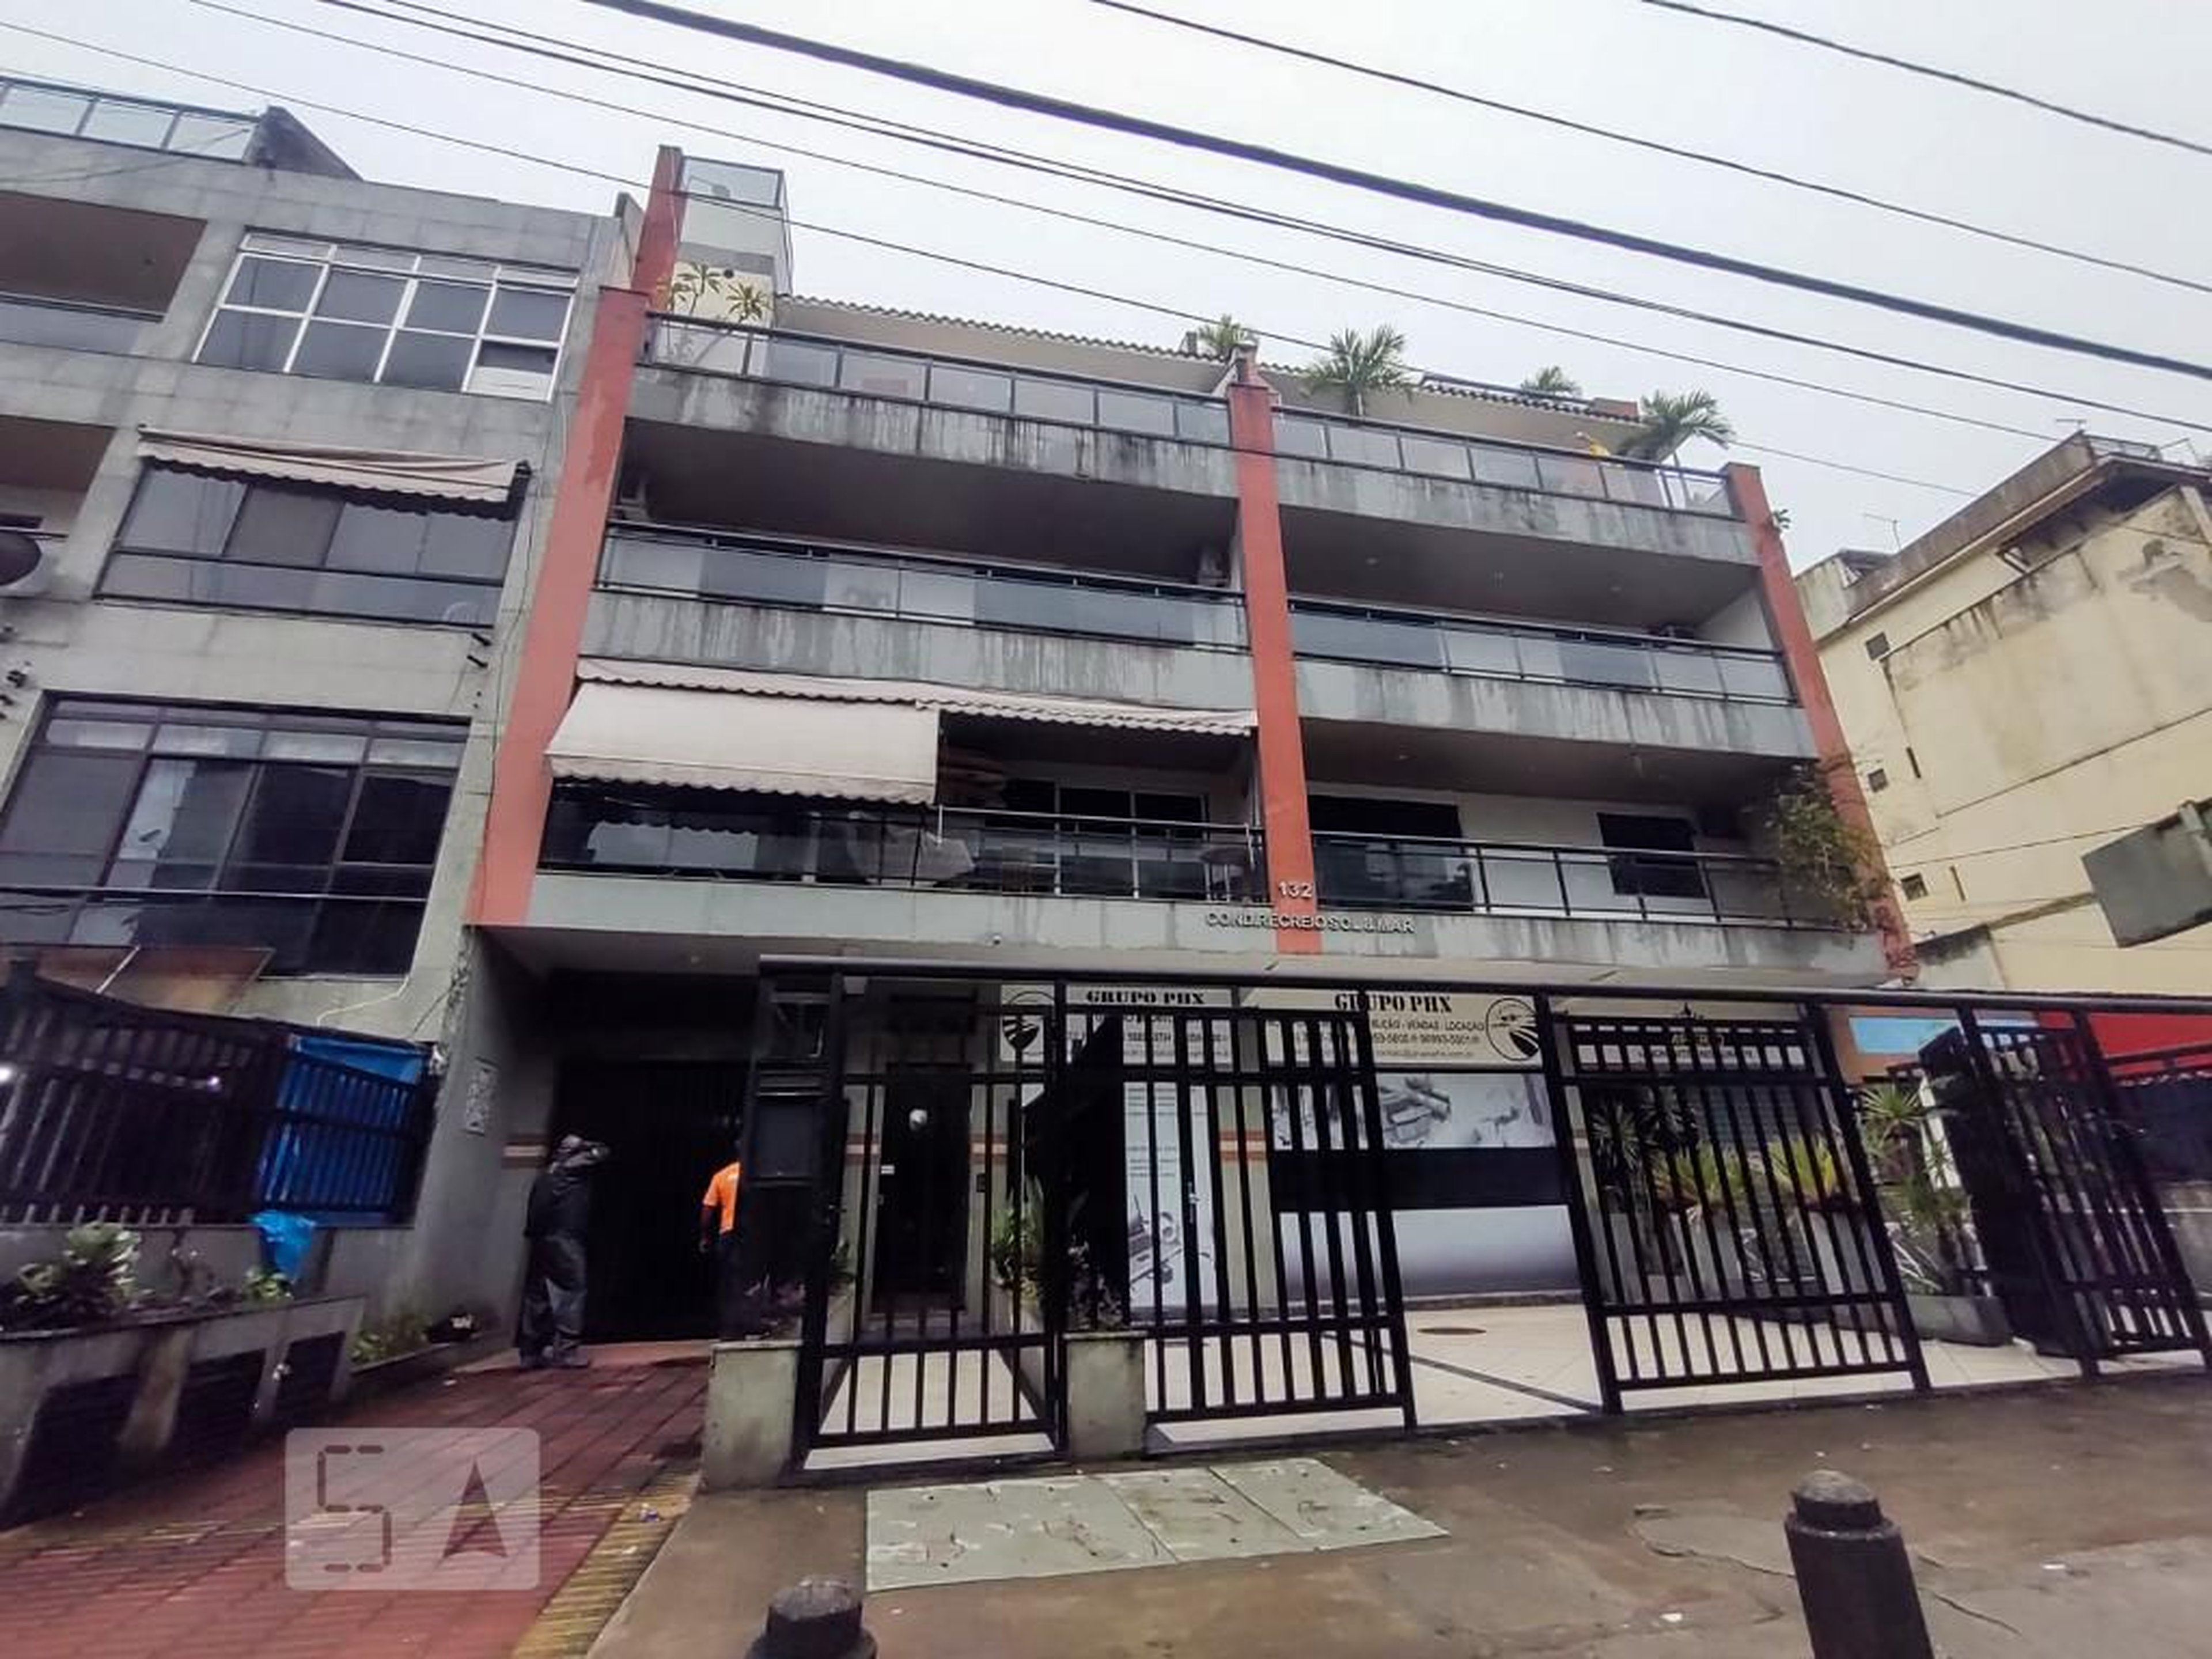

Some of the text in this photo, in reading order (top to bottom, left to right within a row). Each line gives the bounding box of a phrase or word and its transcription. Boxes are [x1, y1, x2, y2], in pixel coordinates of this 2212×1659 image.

[1279, 882, 1312, 898] 132
[1086, 990, 1157, 1003] GRUPO
[1409, 995, 1452, 1013] PHX
